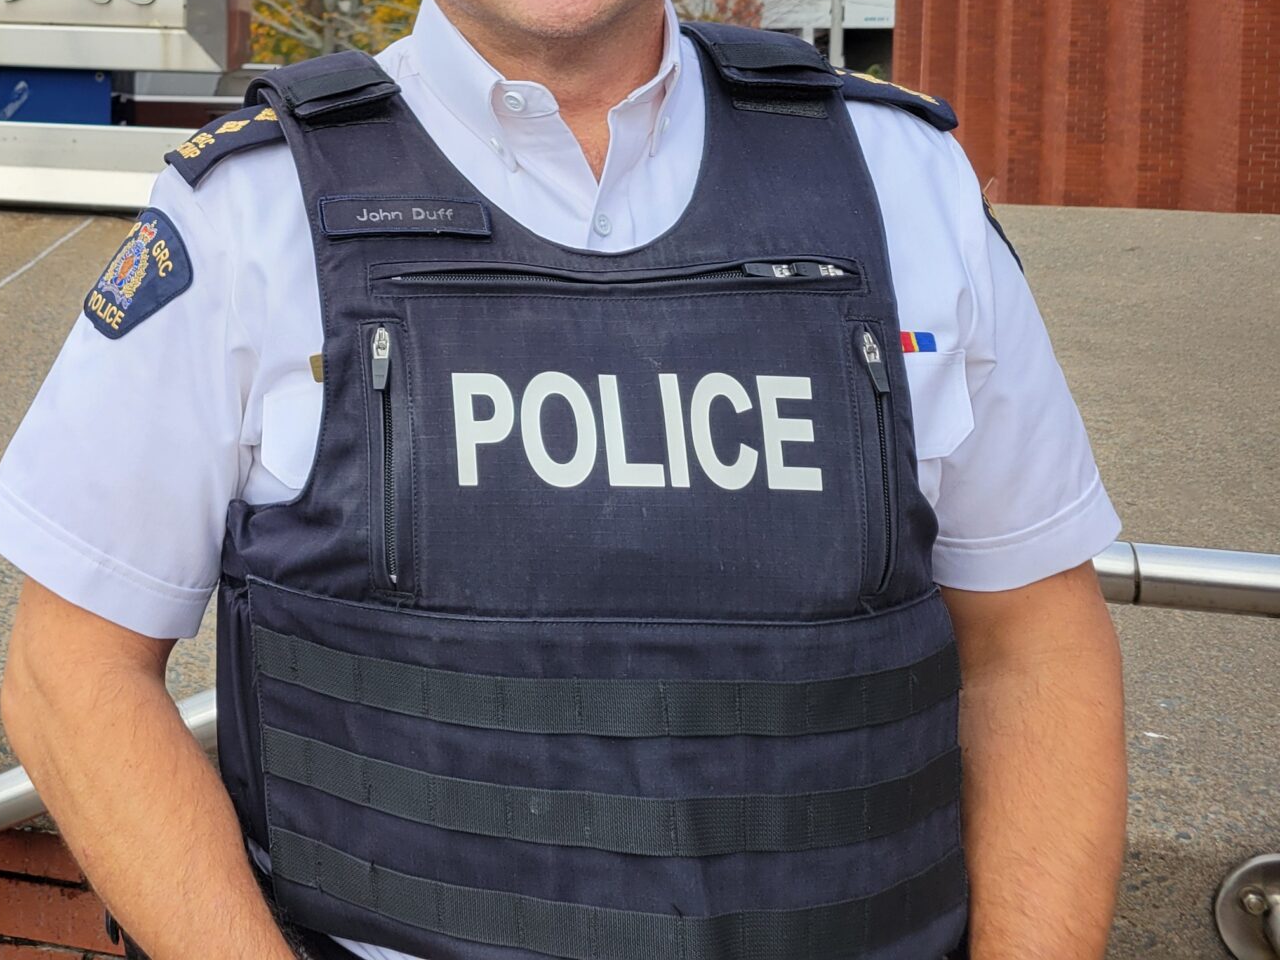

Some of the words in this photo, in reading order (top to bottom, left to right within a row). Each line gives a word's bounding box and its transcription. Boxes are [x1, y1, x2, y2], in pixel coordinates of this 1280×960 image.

[356, 208, 403, 222] John
[411, 207, 454, 222] Duff
[151, 239, 173, 277] GRC
[451, 371, 823, 491] POLICE
